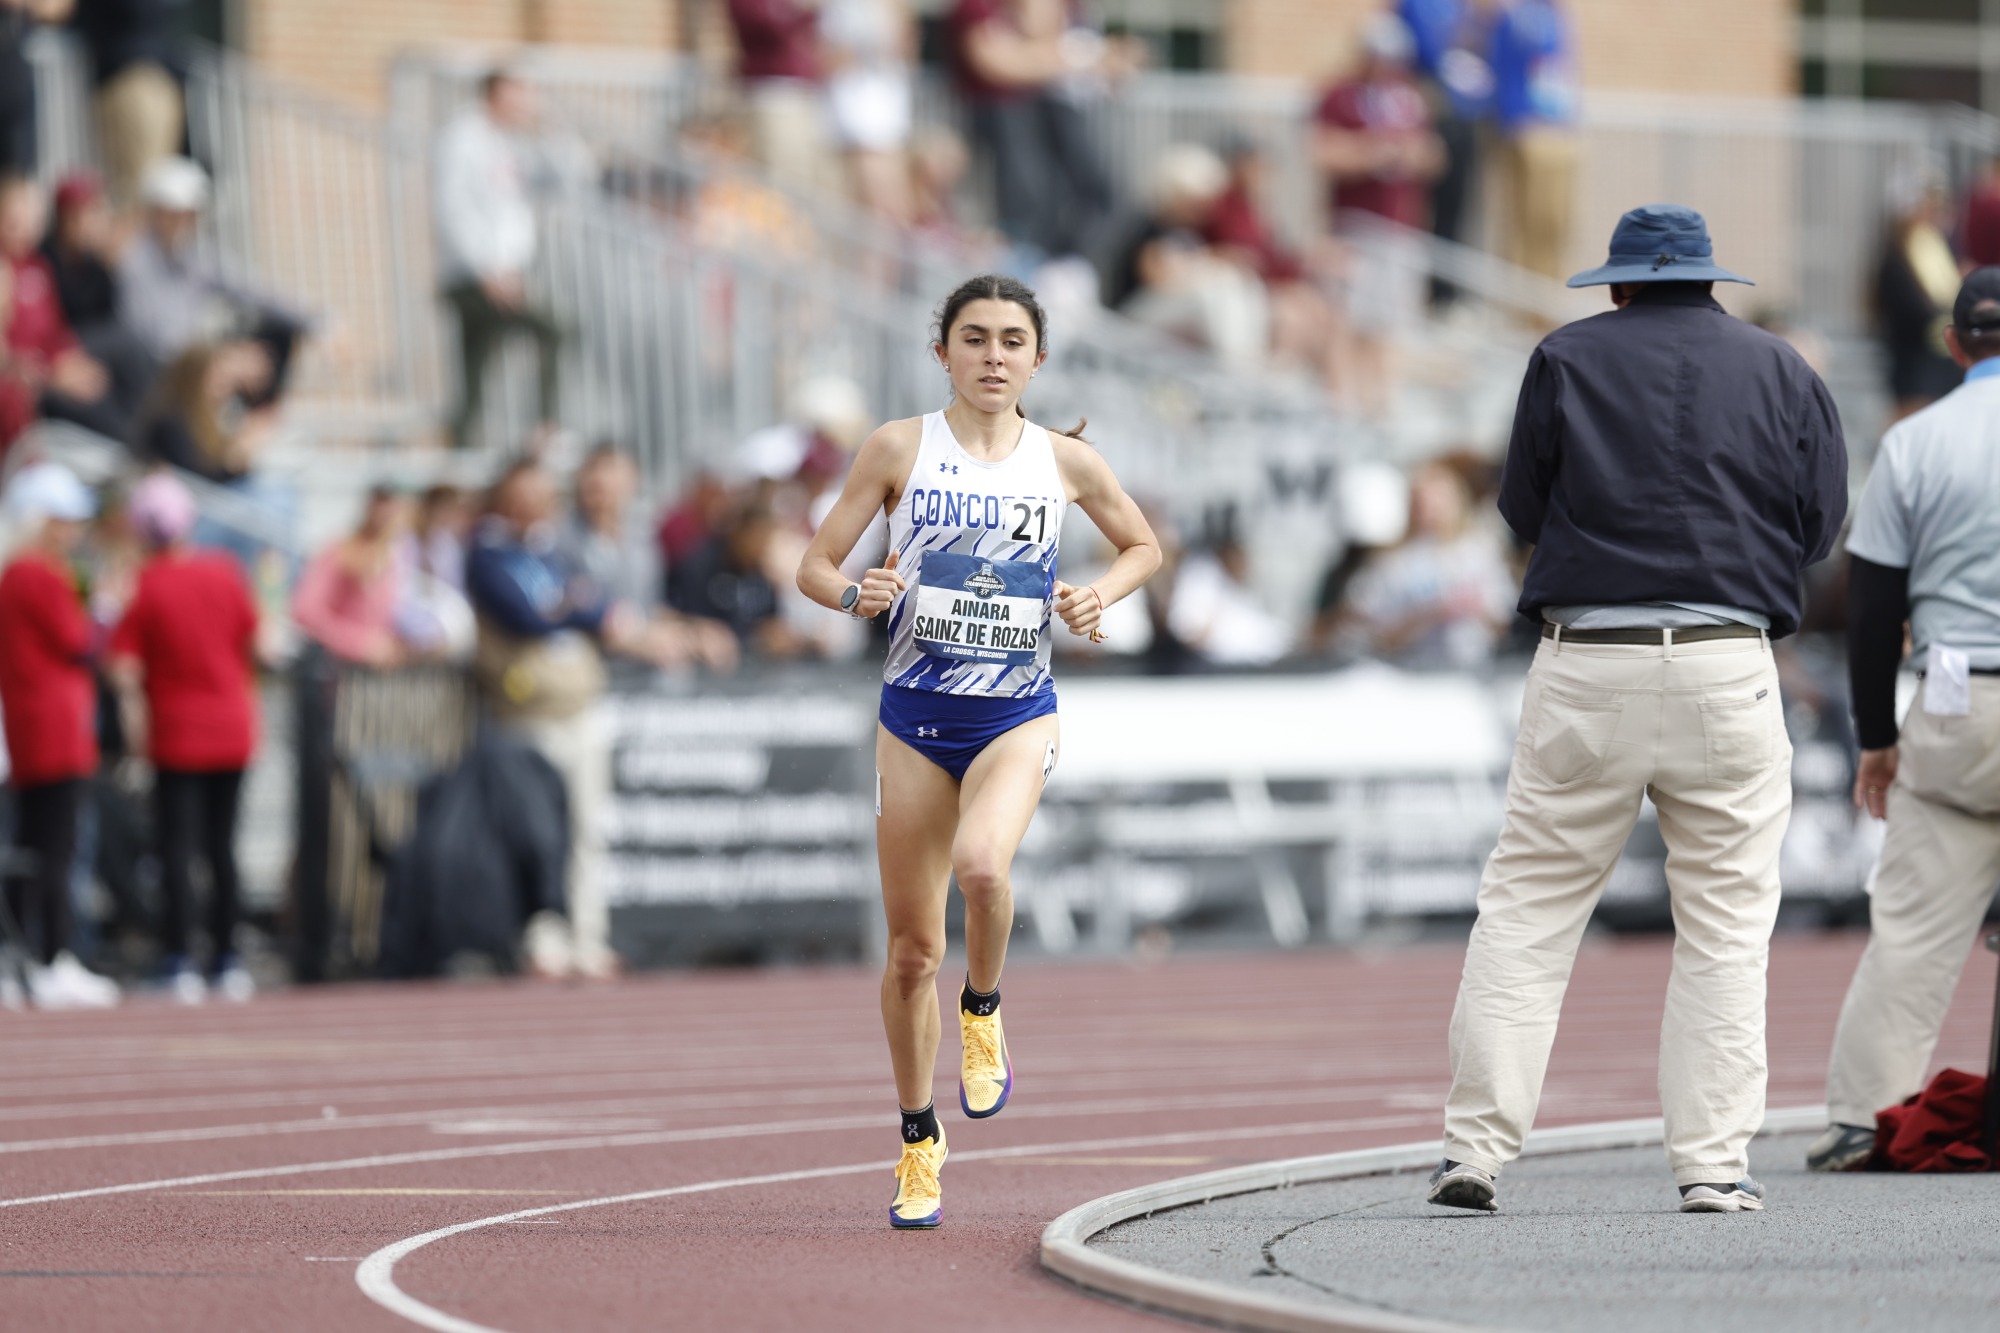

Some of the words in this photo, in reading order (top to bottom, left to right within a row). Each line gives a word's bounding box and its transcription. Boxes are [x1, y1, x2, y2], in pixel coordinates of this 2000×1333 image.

[911, 488, 1057, 530] CONCO
[1012, 503, 1046, 543] 21
[951, 599, 1010, 621] AINARA
[915, 615, 963, 643] SAINZ
[966, 623, 986, 646] DE
[991, 625, 1039, 650] ROZAS
[951, 647, 976, 657] CROSSE,
[977, 650, 1009, 659] WISCONSIN
